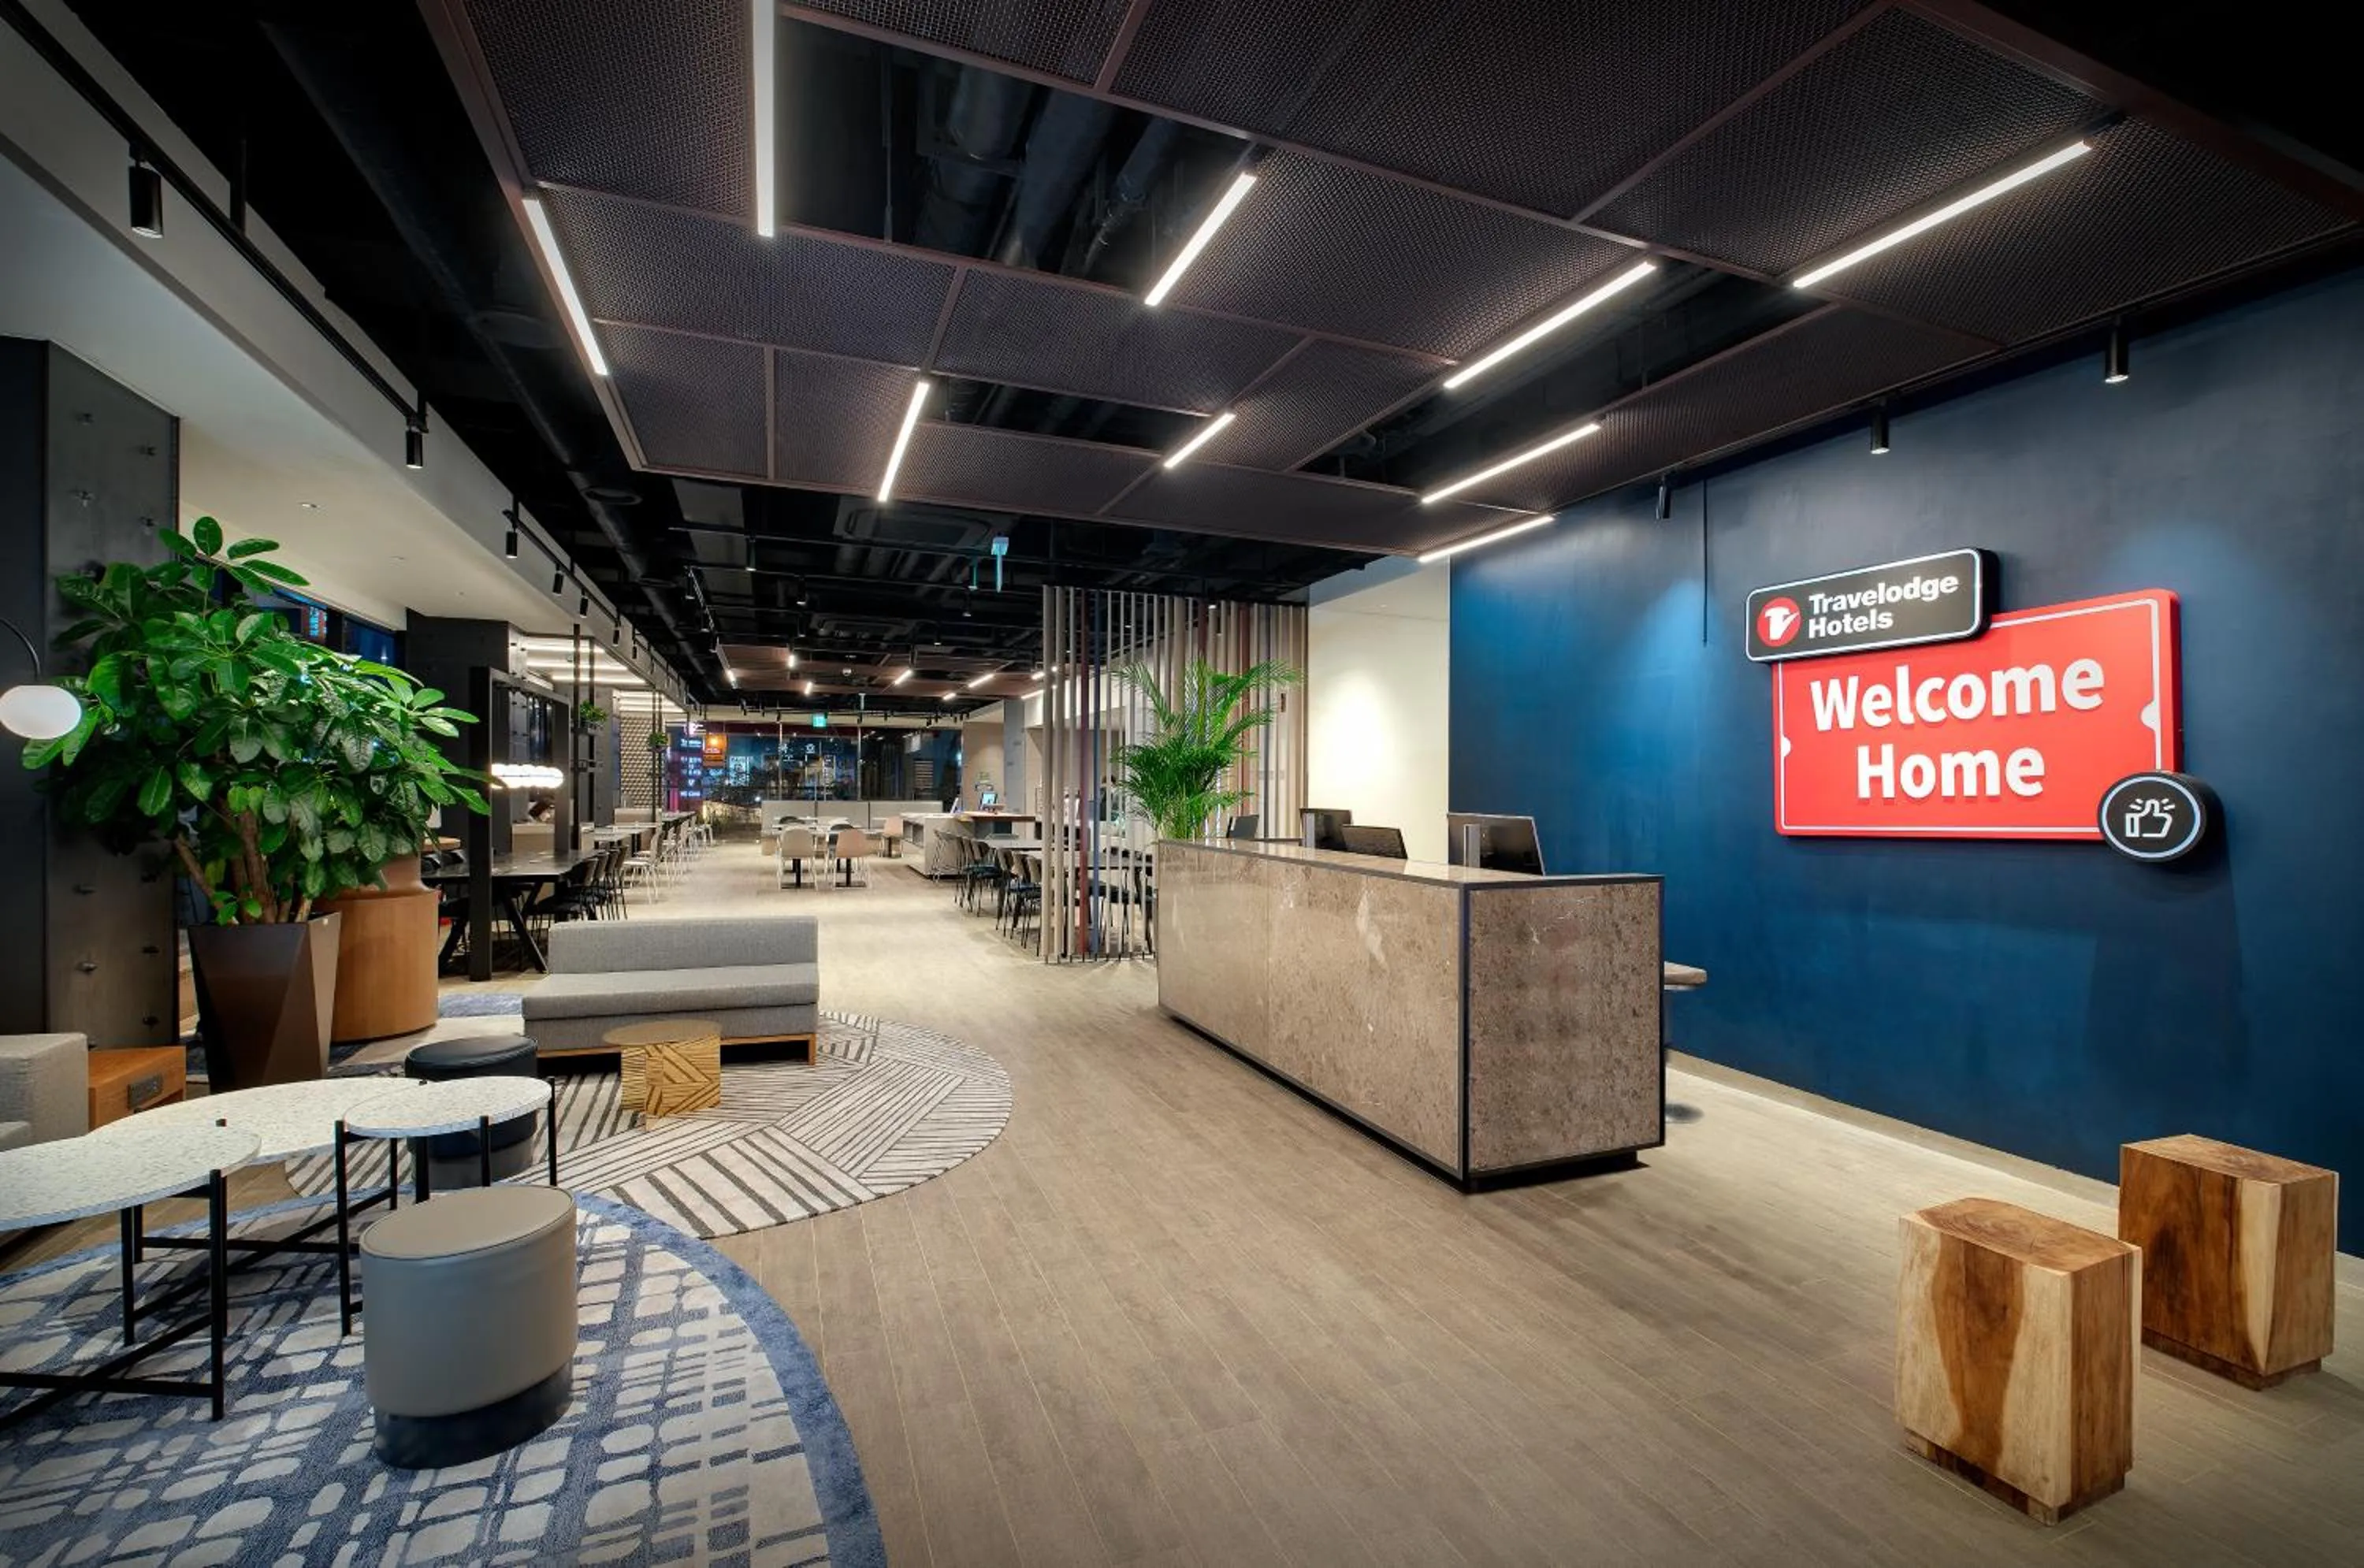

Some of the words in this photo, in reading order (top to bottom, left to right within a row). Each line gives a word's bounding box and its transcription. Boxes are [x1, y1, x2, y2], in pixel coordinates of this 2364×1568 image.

[1808, 575, 1960, 615] Travelodge
[1808, 608, 1894, 639] Hotels
[1810, 658, 2105, 731] Welcome
[1857, 743, 2046, 799] Home
